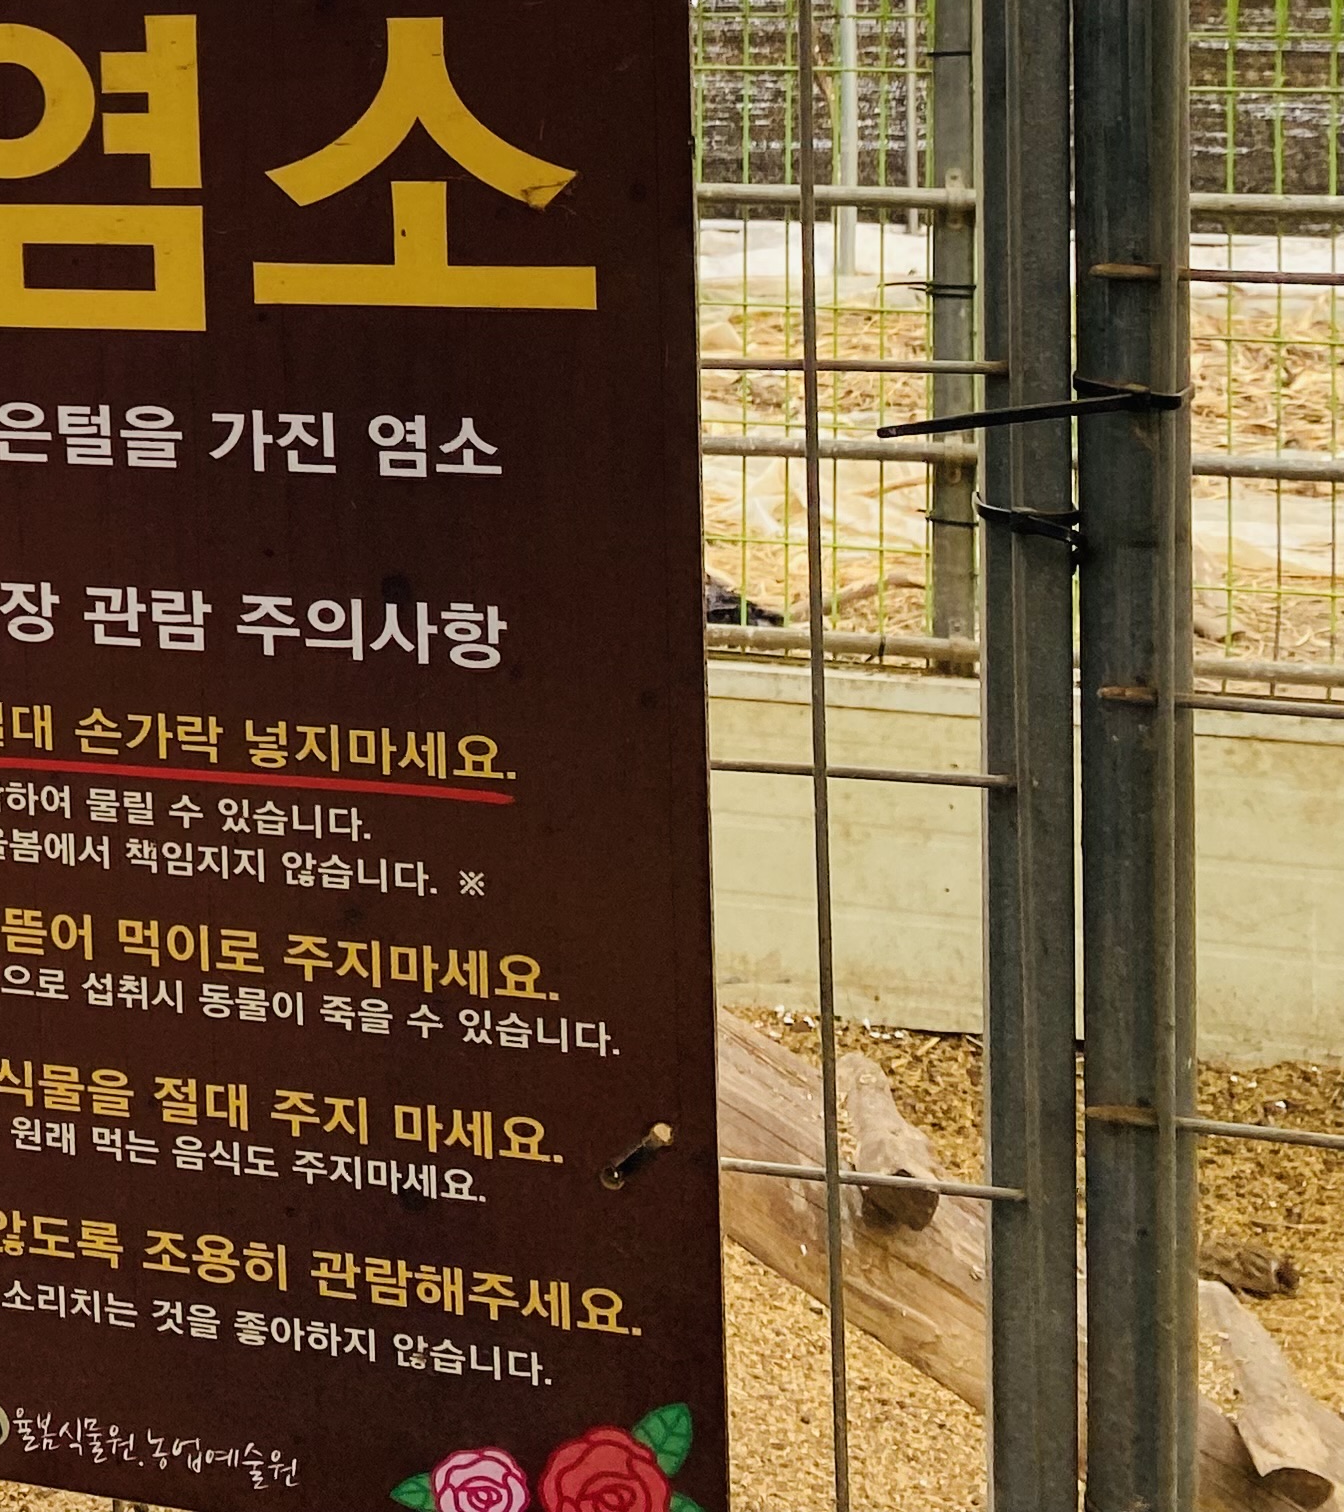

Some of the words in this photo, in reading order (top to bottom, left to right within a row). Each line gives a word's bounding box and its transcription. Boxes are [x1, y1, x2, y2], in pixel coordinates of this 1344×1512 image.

[208, 409, 337, 474] 가진
[368, 414, 503, 478] 염소
[83, 586, 213, 652] 관람
[236, 594, 508, 669] 주의사항
[74, 707, 224, 764] 손가락
[245, 719, 516, 780] 넣지마세요.
[85, 787, 155, 826] 물릴
[168, 794, 204, 829] 수
[217, 798, 371, 842] 있습니다.
[125, 838, 265, 883] 책임지지
[281, 851, 438, 897] 않습니다.
[1, 907, 93, 961] 뜯어
[118, 919, 265, 974] 먹이로
[283, 934, 560, 1001] 주지마세요.
[81, 972, 184, 1014] 섭취시
[198, 983, 304, 1026] 동물이
[319, 994, 394, 1035] 죽을
[406, 1004, 444, 1039] 수
[458, 1008, 620, 1057] 있습니다.
[10, 1116, 76, 1156] 원래
[91, 1126, 160, 1165] 먹는
[171, 1135, 279, 1177] 음식도
[291, 1149, 487, 1203] 주지마세요.
[153, 1076, 249, 1132] 절대
[270, 1089, 369, 1145] 주지
[394, 1104, 564, 1164] 마세요.
[142, 1230, 287, 1292] 조용히
[310, 1250, 642, 1336] 관람해주세요.
[1, 1279, 138, 1328] 소리치는
[151, 1299, 221, 1340] 것을
[233, 1310, 376, 1363] 좋아하지
[392, 1333, 552, 1387] 않습니다.
